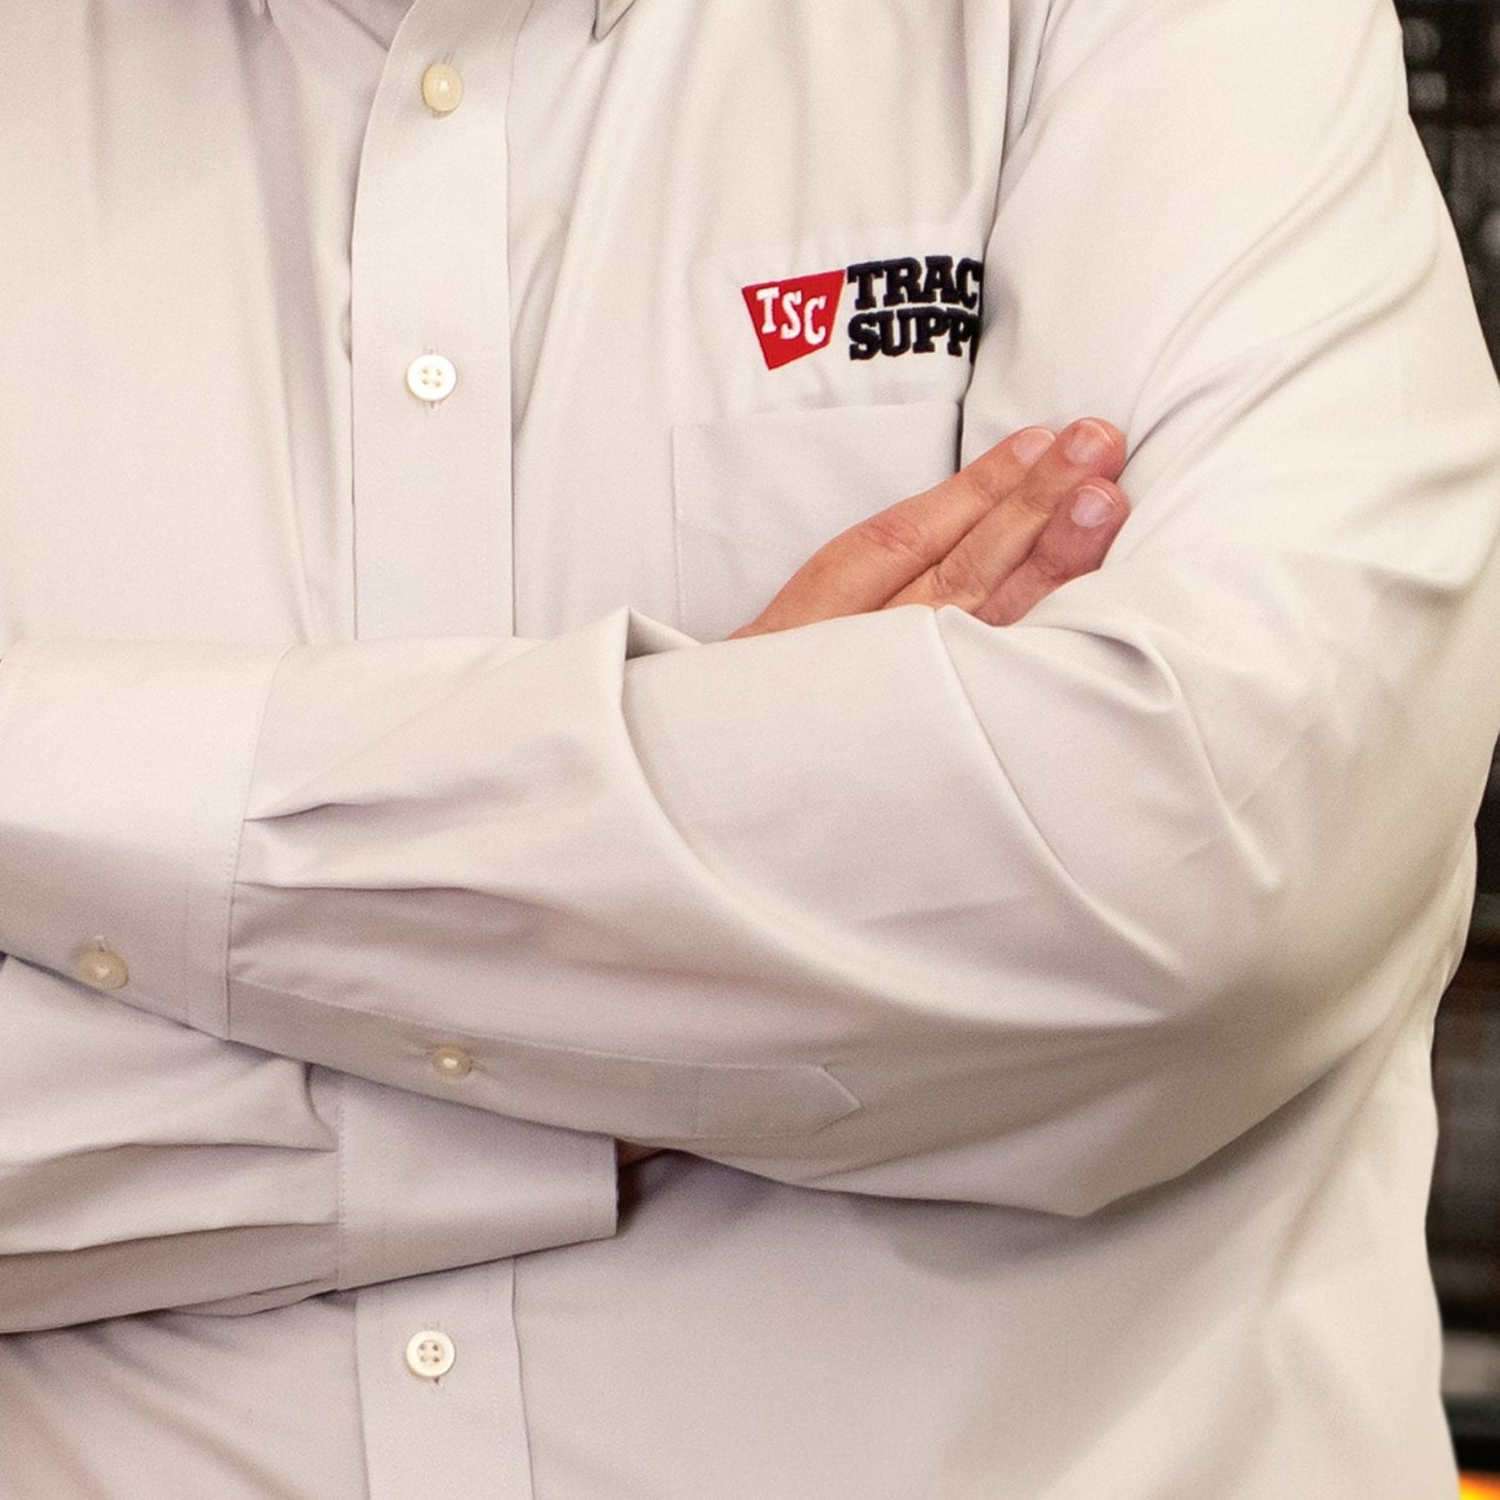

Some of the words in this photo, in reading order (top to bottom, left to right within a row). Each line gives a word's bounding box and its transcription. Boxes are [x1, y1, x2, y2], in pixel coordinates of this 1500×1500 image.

[846, 255, 983, 311] TRAC
[756, 286, 828, 346] TSC
[847, 305, 981, 366] SUPP
